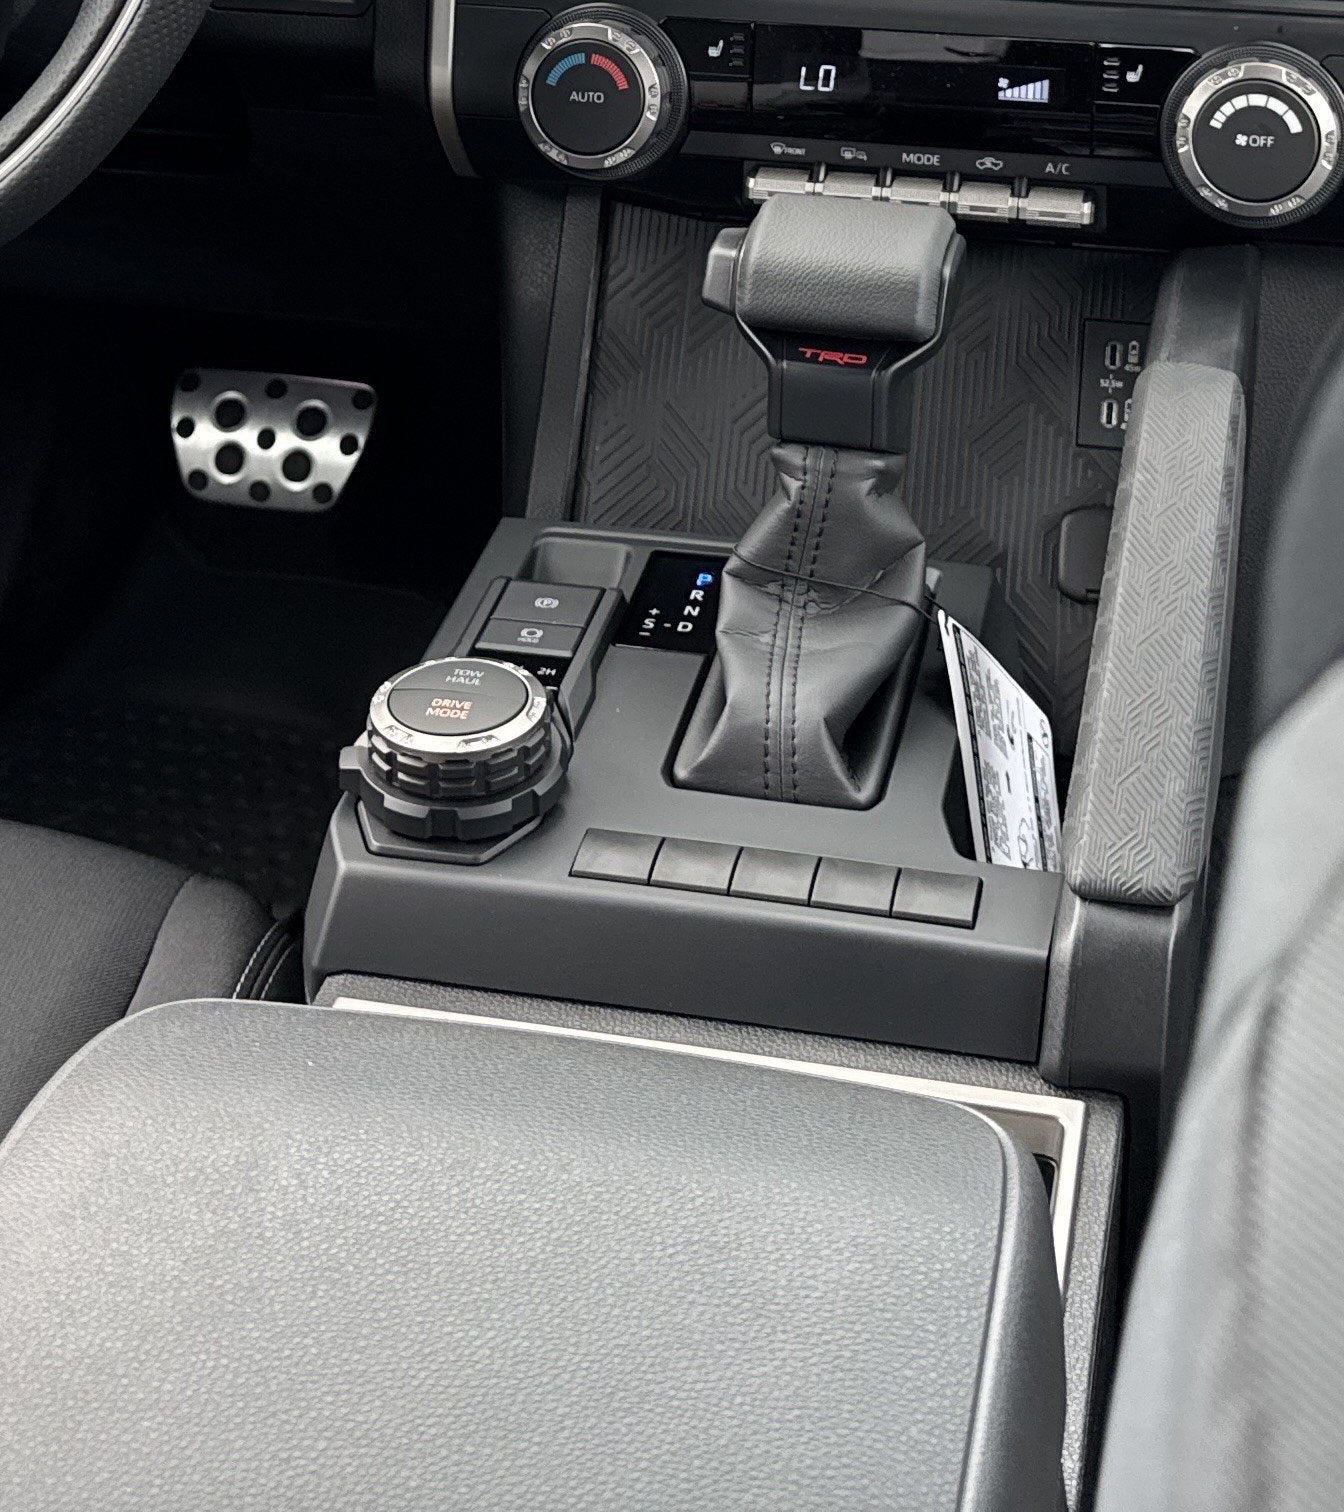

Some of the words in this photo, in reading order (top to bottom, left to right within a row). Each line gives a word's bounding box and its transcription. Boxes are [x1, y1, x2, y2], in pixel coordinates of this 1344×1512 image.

[799, 64, 837, 92] LO
[569, 91, 604, 104] AUTO
[1249, 134, 1275, 148] OFF
[901, 152, 941, 166] MODE
[1044, 162, 1071, 176] A/C
[798, 347, 868, 365] TRD
[696, 573, 713, 586] P
[689, 589, 705, 601] R
[683, 605, 700, 617] N
[642, 618, 656, 629] S
[677, 621, 693, 632] D
[453, 668, 485, 678] TOW
[537, 666, 557, 676] 2H
[445, 675, 481, 687] HAUL
[430, 697, 474, 710] DRIVE
[425, 707, 471, 721] MODE
